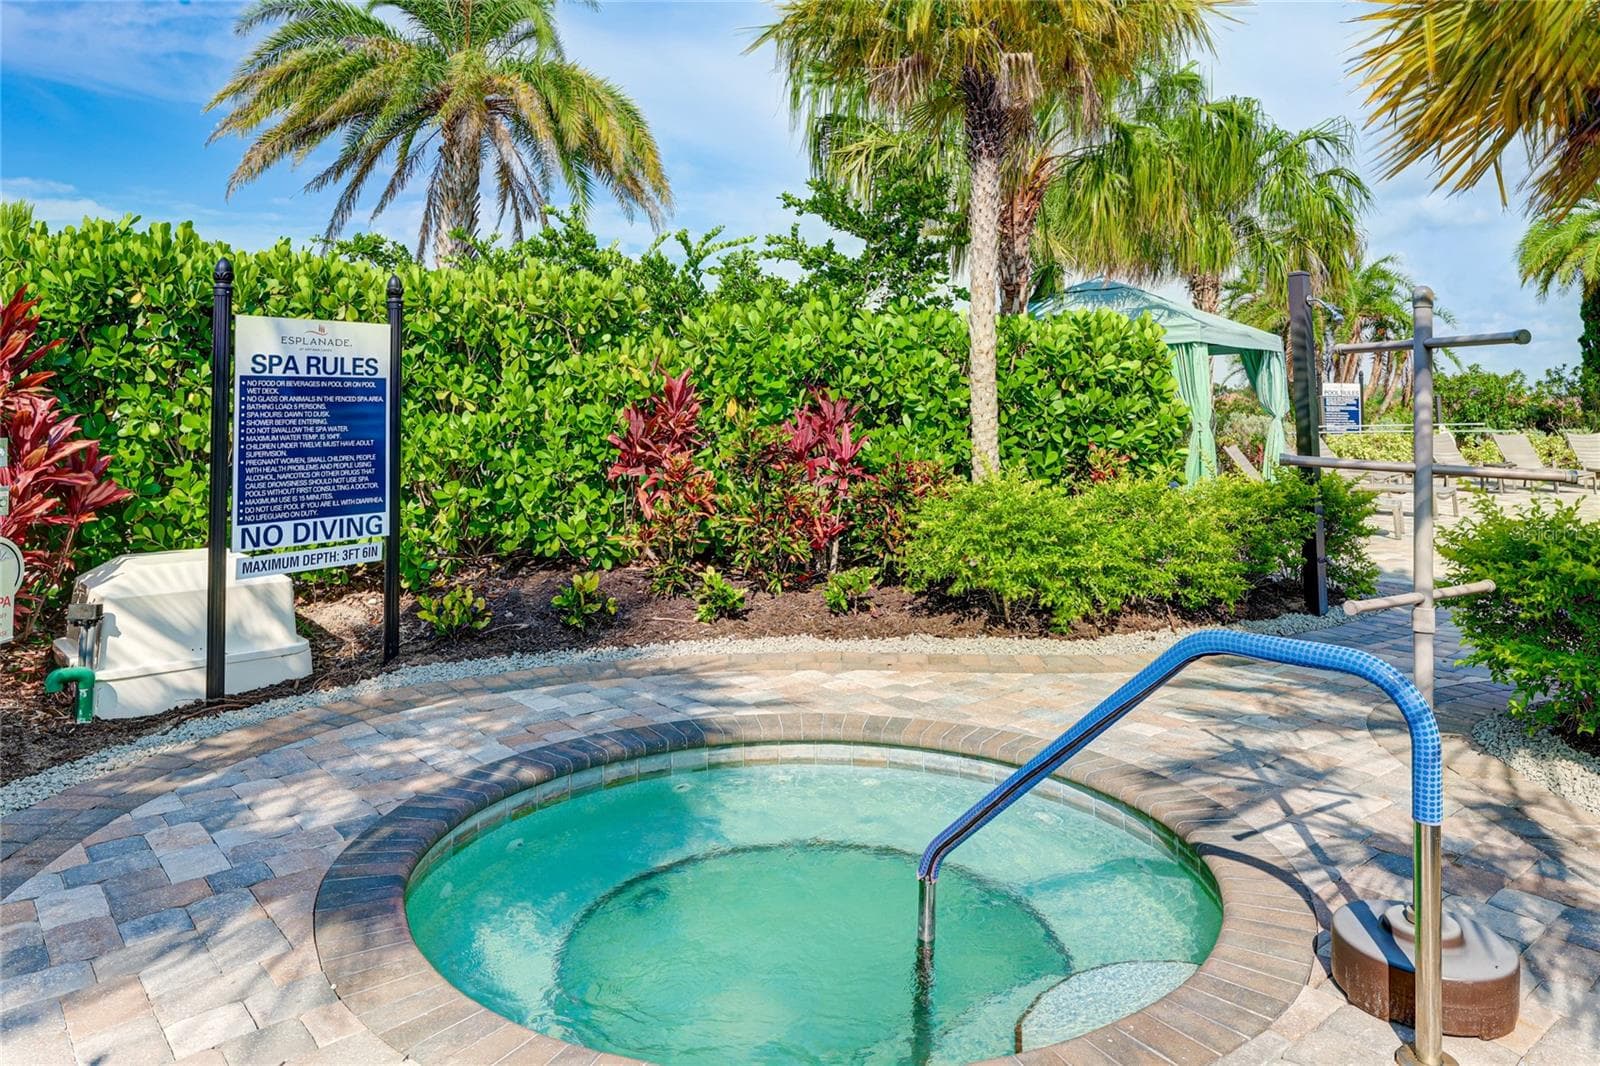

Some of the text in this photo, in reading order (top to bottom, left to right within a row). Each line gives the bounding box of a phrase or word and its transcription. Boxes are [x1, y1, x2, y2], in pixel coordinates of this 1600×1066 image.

[251, 354, 379, 377] SPA RULES
[276, 442, 298, 450] UNDER
[300, 440, 322, 448] TWELVE
[246, 458, 280, 466] PREGNANT
[262, 465, 286, 473] HEALTH
[287, 464, 319, 472] PROBLEMS
[276, 472, 310, 480] NARCOTICS
[268, 479, 308, 488] DROWSINESS
[308, 478, 332, 486] SHOULD
[245, 490, 266, 498] POOLS
[266, 488, 296, 496] WITHOUT
[312, 484, 350, 493] CONSULTING
[244, 497, 278, 506] MAXIMUM
[256, 512, 290, 521] LIFEGUARD
[241, 514, 383, 549] NO DIVING
[242, 545, 378, 574] MAXIMUM DEPTH: 3FT 6IN
